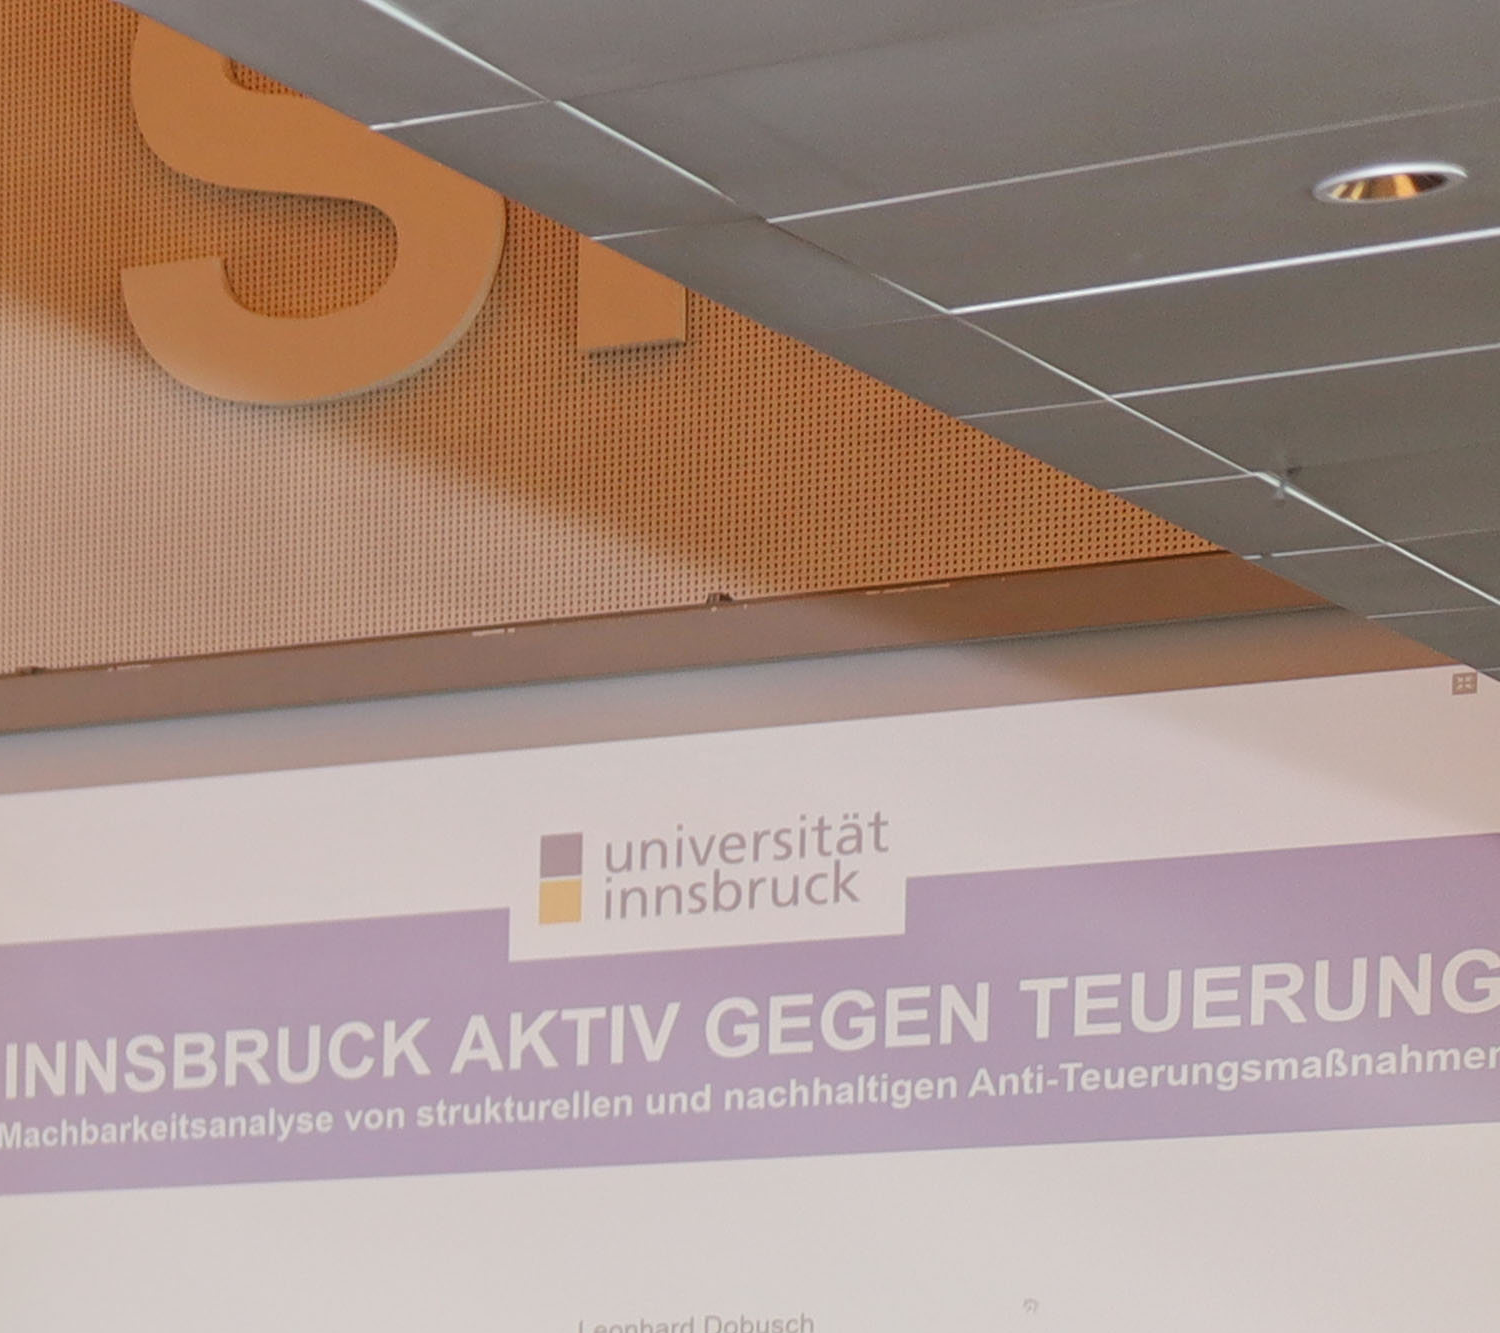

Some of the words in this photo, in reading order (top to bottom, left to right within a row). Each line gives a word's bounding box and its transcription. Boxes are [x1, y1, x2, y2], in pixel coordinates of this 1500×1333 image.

[605, 811, 890, 874] universität
[604, 859, 861, 921] innsbruck
[4, 1018, 432, 1101] INNSBRUCK
[449, 1002, 681, 1076] AKTIV
[704, 981, 991, 1060] GEGEN
[1019, 948, 1500, 1039] TEUERUNG
[345, 1103, 405, 1131] von
[416, 1090, 634, 1128] strukturellen
[645, 1082, 712, 1116] und
[723, 1071, 958, 1114] nachhaltigen
